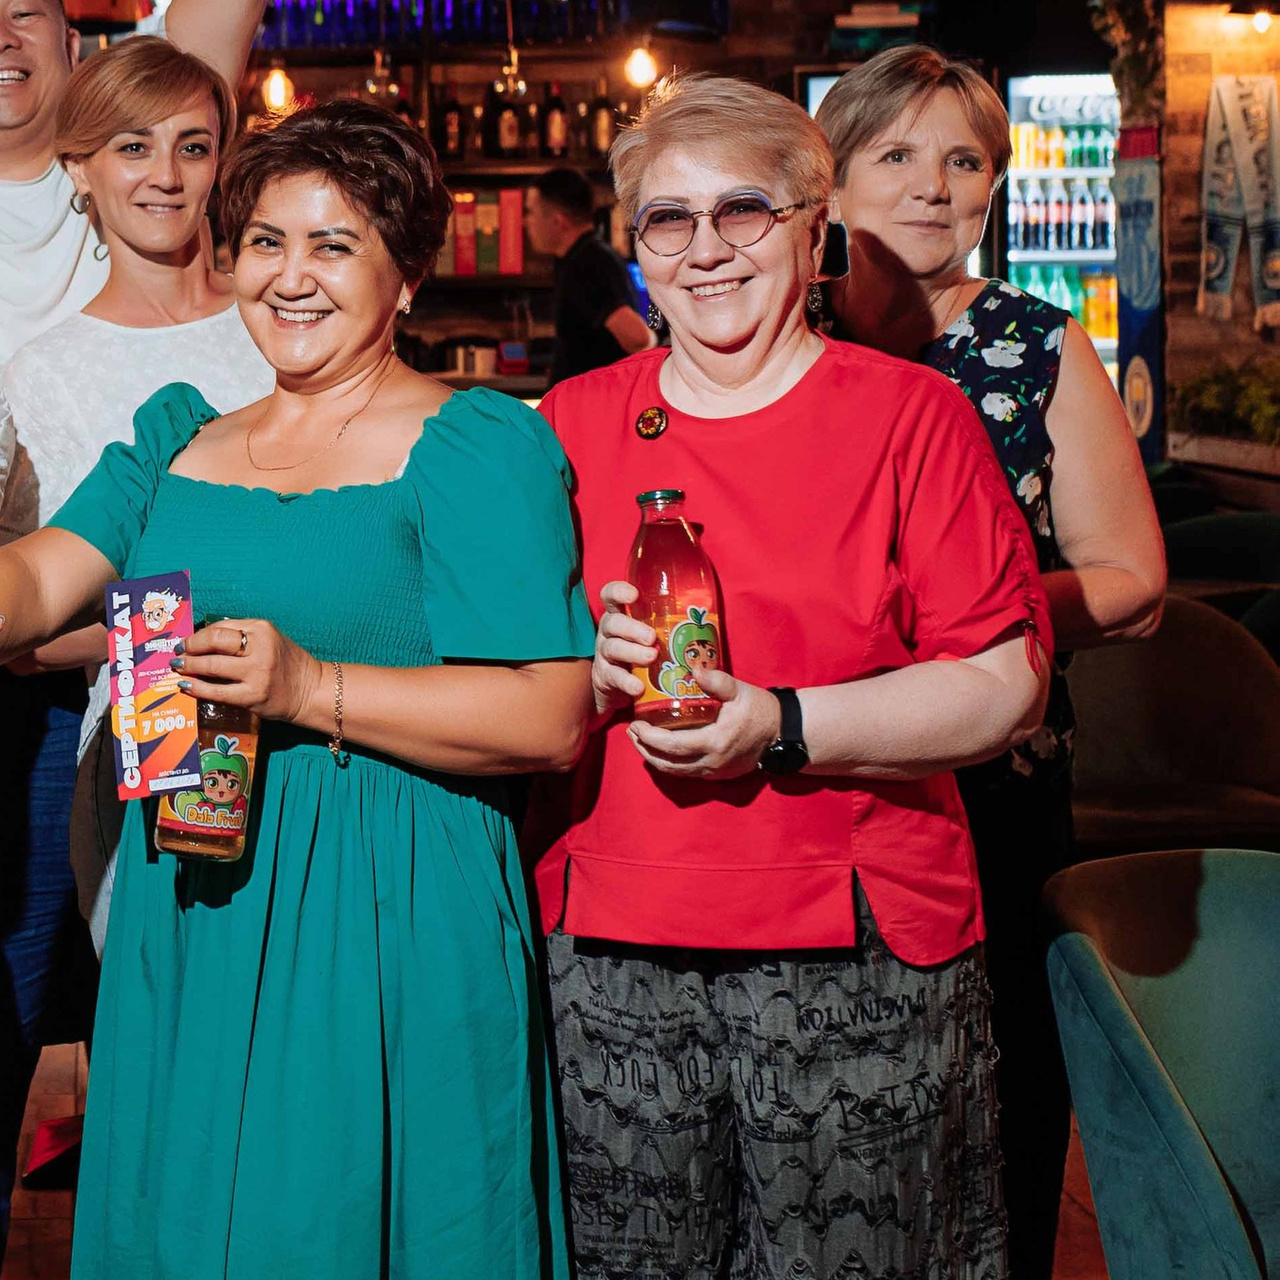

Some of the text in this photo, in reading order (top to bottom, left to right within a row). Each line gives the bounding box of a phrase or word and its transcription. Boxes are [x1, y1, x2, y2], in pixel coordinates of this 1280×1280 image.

[142, 721, 151, 735] 7
[154, 715, 186, 734] 000
[187, 807, 243, 827] Dala Fruit
